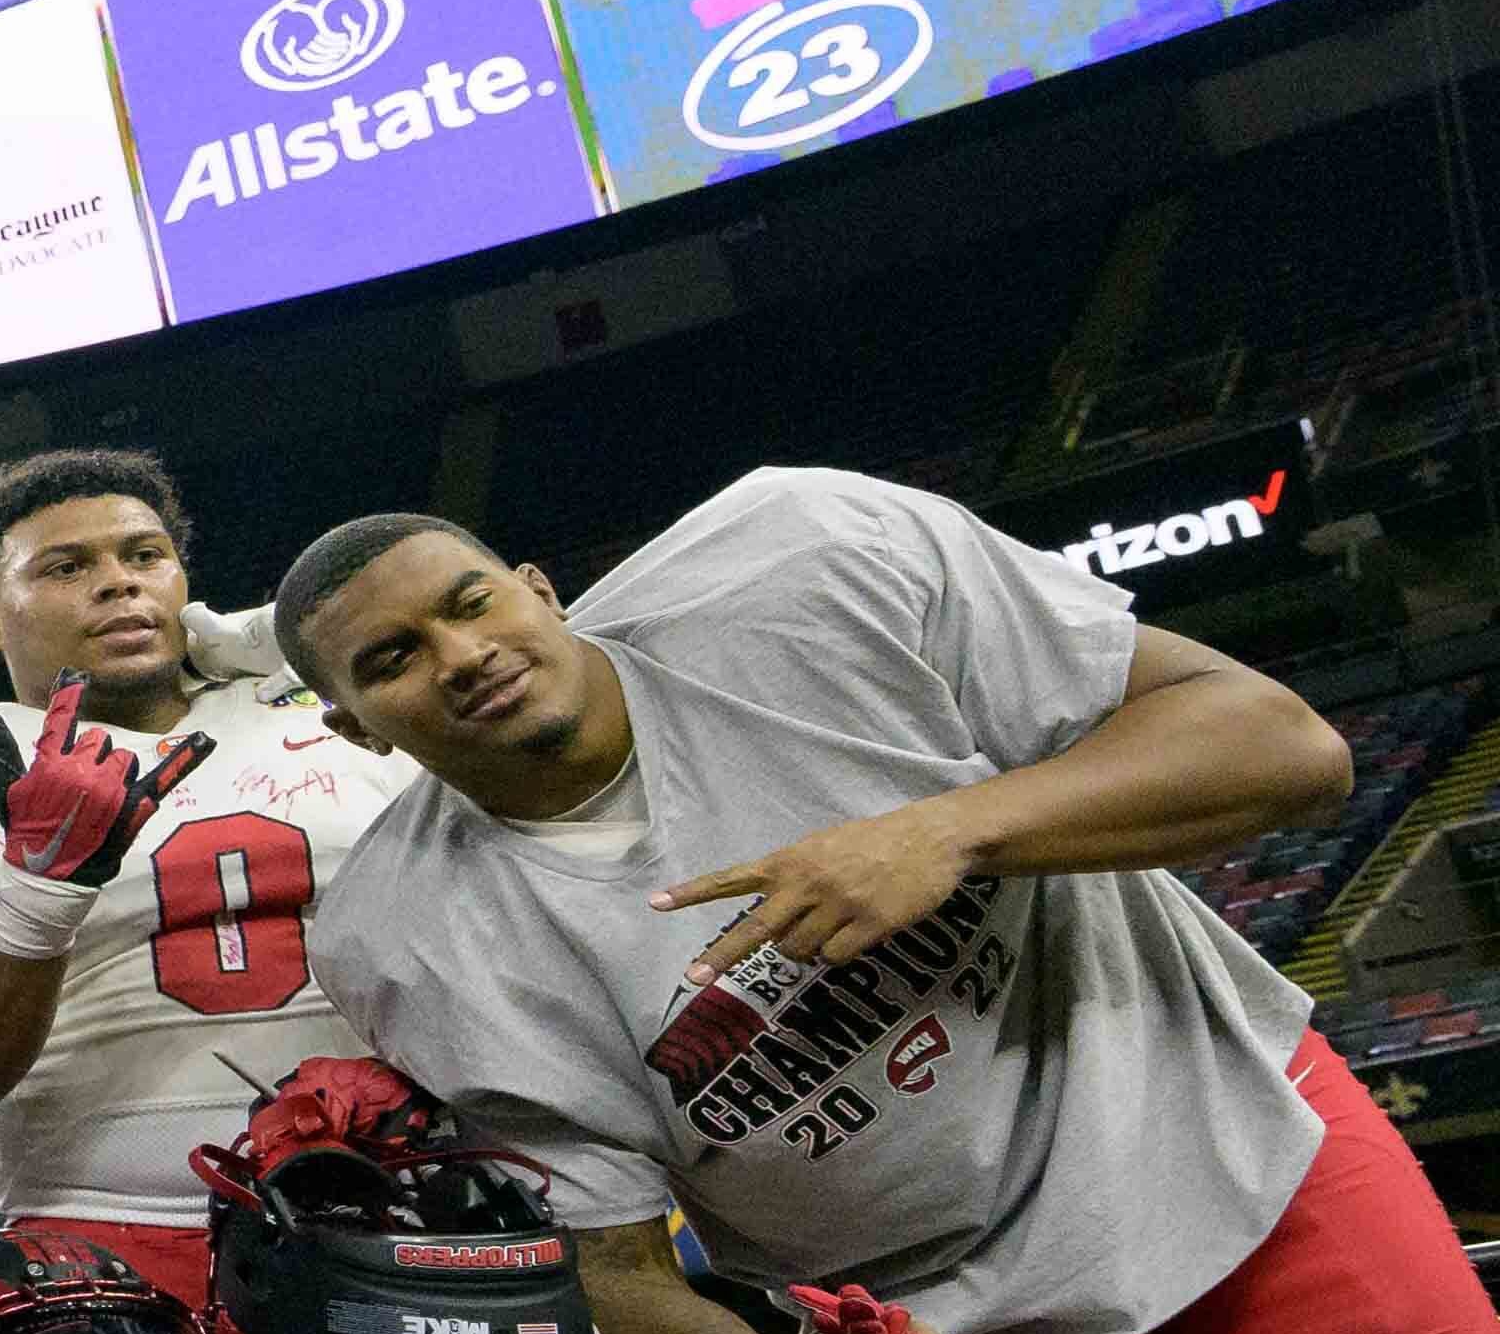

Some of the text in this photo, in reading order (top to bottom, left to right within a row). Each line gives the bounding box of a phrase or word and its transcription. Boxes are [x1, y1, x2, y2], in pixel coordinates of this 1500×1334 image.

[727, 23, 881, 128] 23
[894, 1030, 938, 1067] WKU
[780, 1082, 881, 1164] 20
